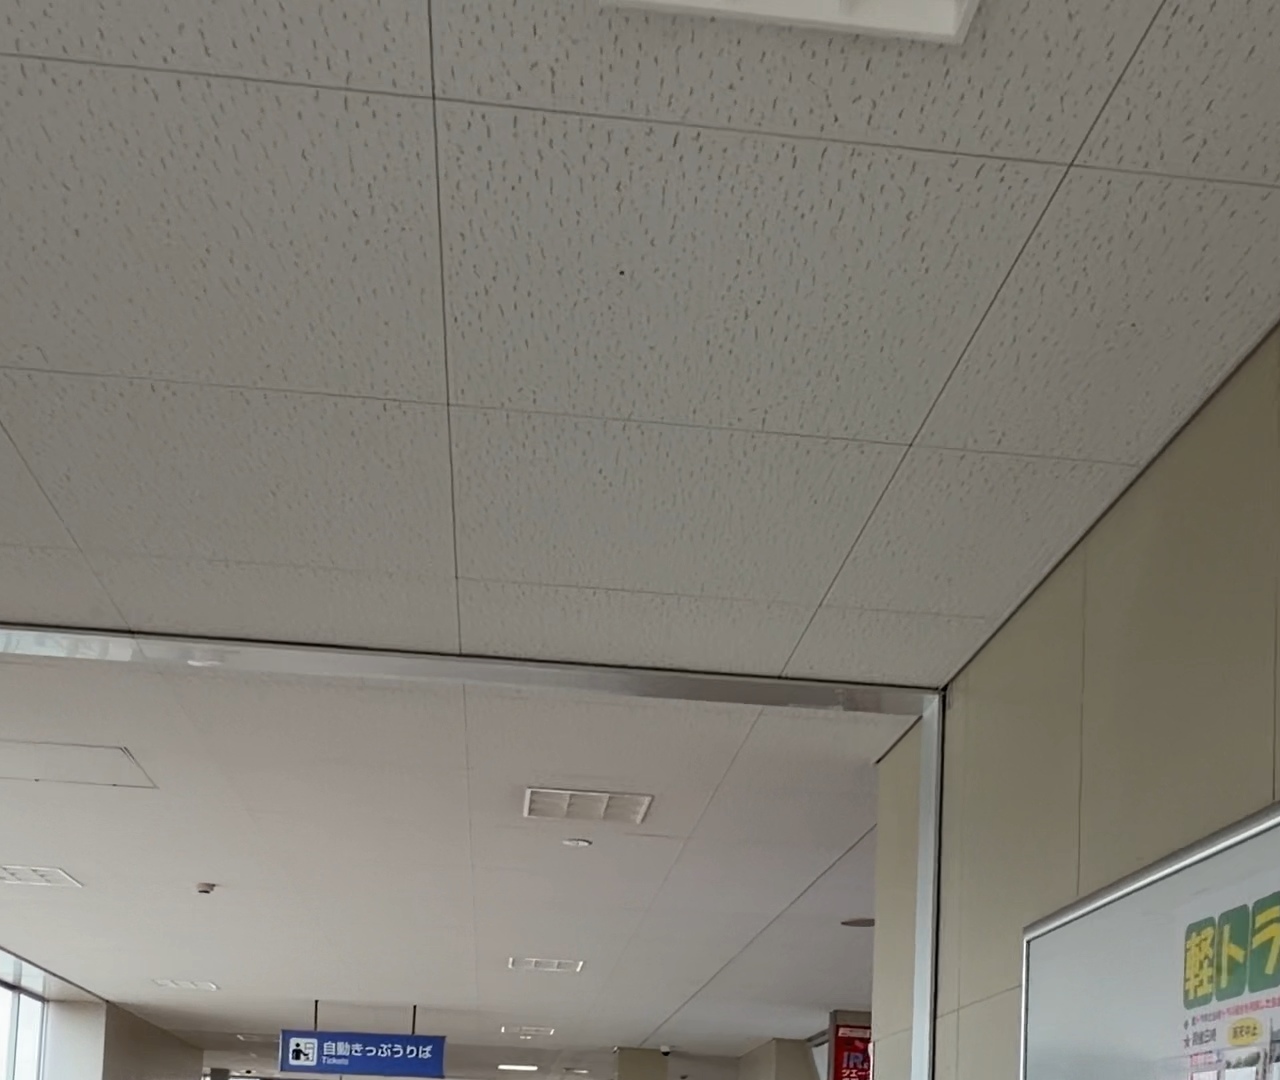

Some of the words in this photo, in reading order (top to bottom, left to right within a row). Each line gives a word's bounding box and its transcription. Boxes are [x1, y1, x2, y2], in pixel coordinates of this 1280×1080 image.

[323, 1041, 433, 1059] 自動きっぷうりば
